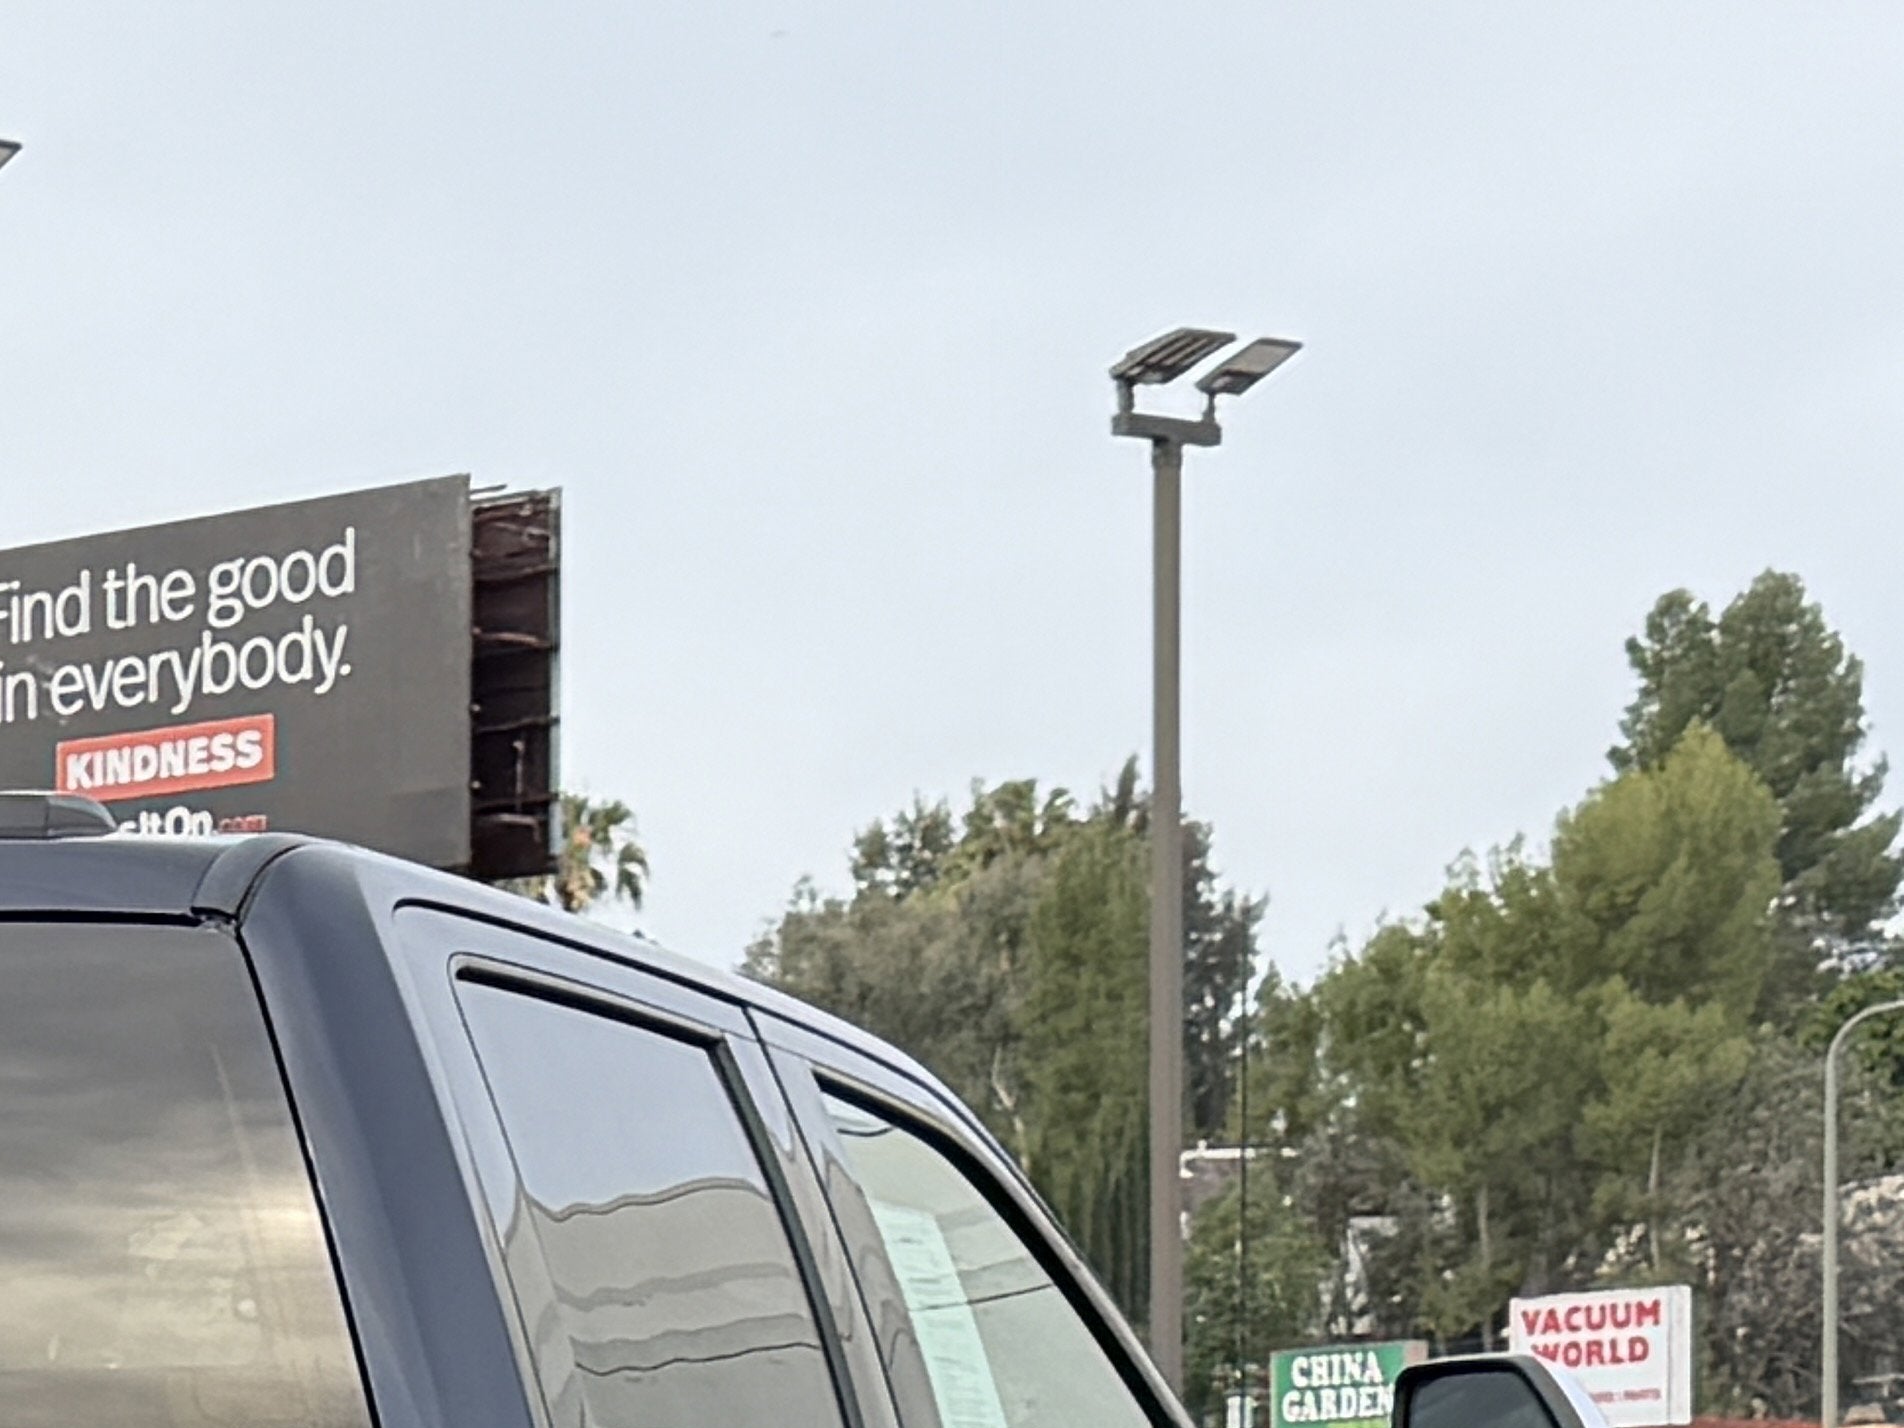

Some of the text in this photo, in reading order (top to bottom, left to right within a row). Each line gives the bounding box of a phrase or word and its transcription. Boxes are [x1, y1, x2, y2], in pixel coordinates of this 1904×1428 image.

[103, 562, 196, 629] the
[207, 526, 355, 628] good
[49, 614, 353, 715] everybody.
[66, 729, 263, 790] KINDNESS
[1522, 1299, 1661, 1336] VACUUM
[1291, 1350, 1383, 1387] CHINA
[1531, 1337, 1650, 1368] WORLD
[1281, 1387, 1393, 1423] GARDEN
